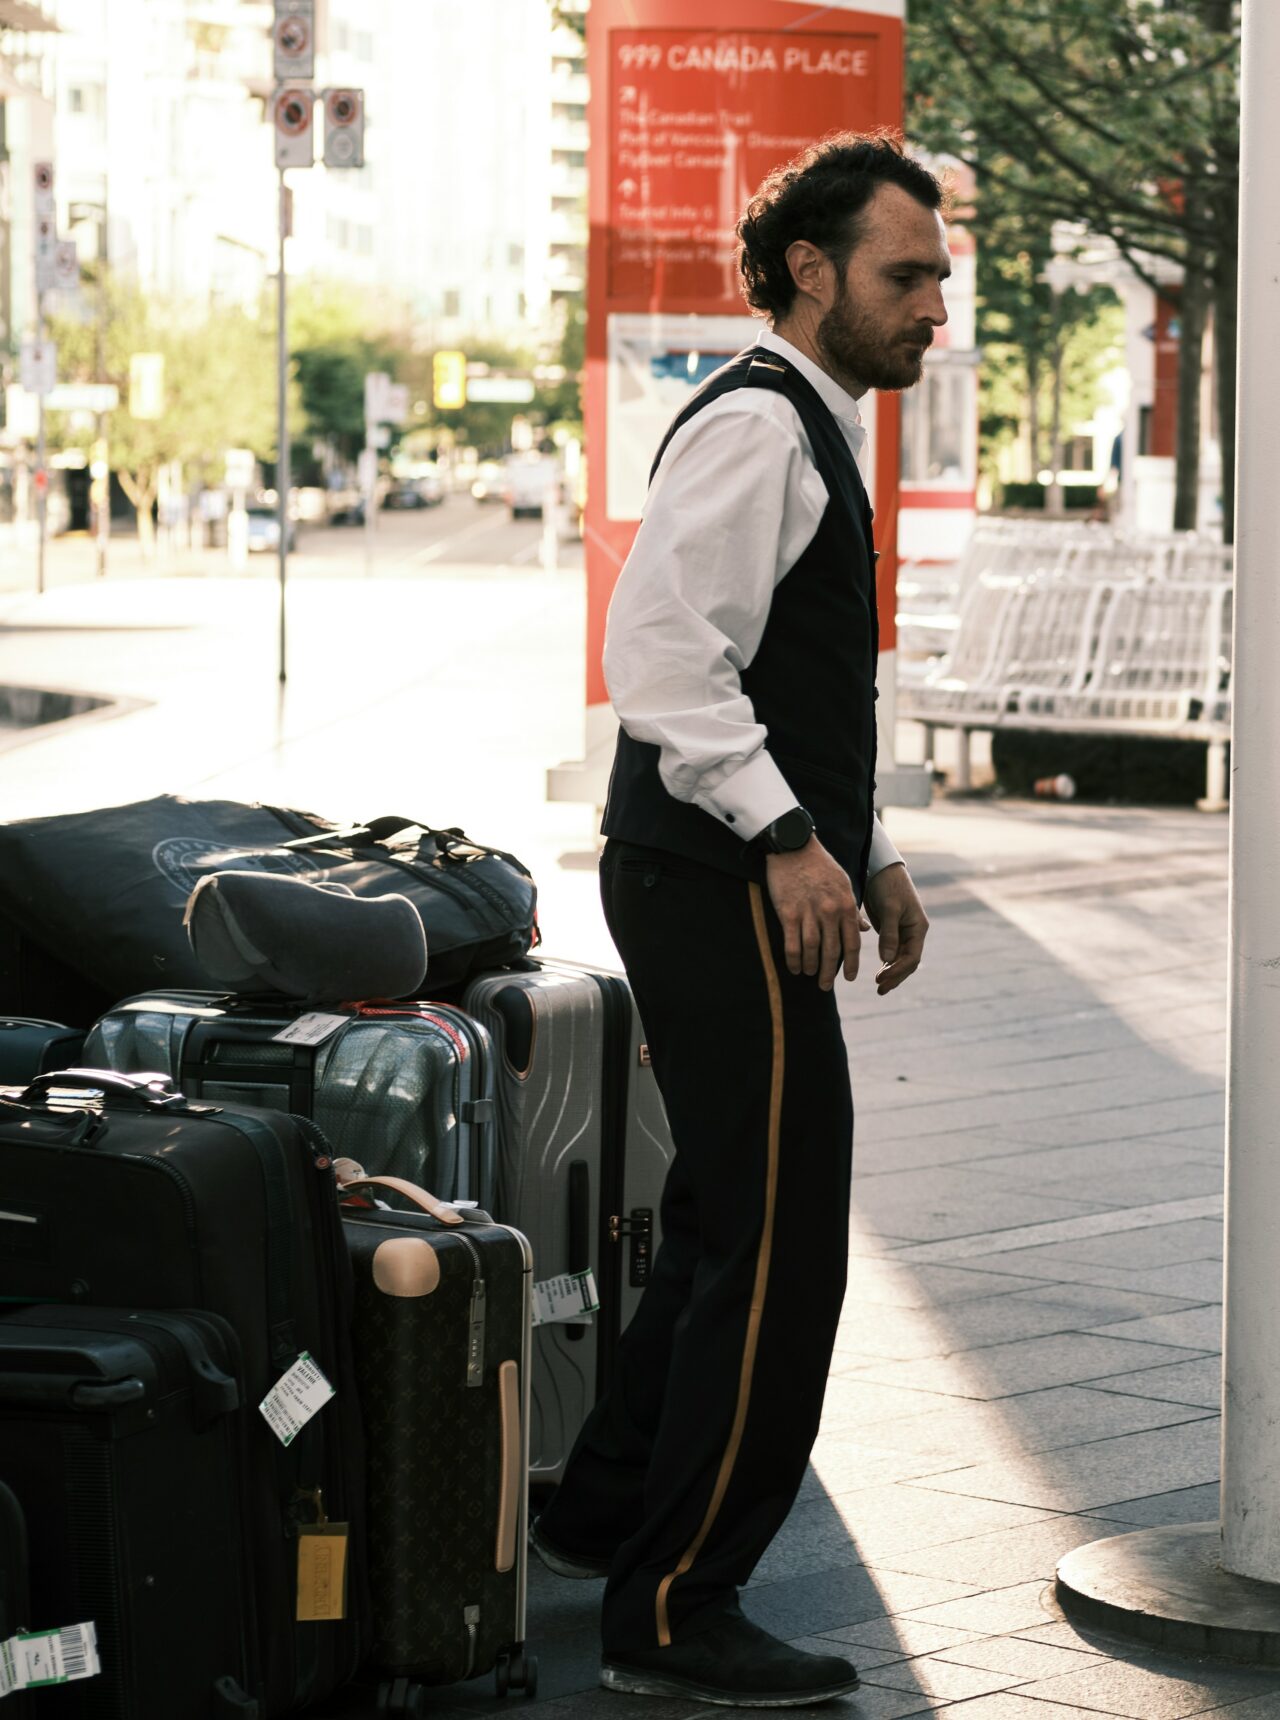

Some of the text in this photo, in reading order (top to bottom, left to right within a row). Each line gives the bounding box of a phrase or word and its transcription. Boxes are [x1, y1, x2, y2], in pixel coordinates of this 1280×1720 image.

[618, 44, 868, 76] 999 CANADA PLACE
[649, 107, 716, 127] Canadian
[671, 130, 743, 148] Vancouvr
[674, 150, 733, 169] Canad
